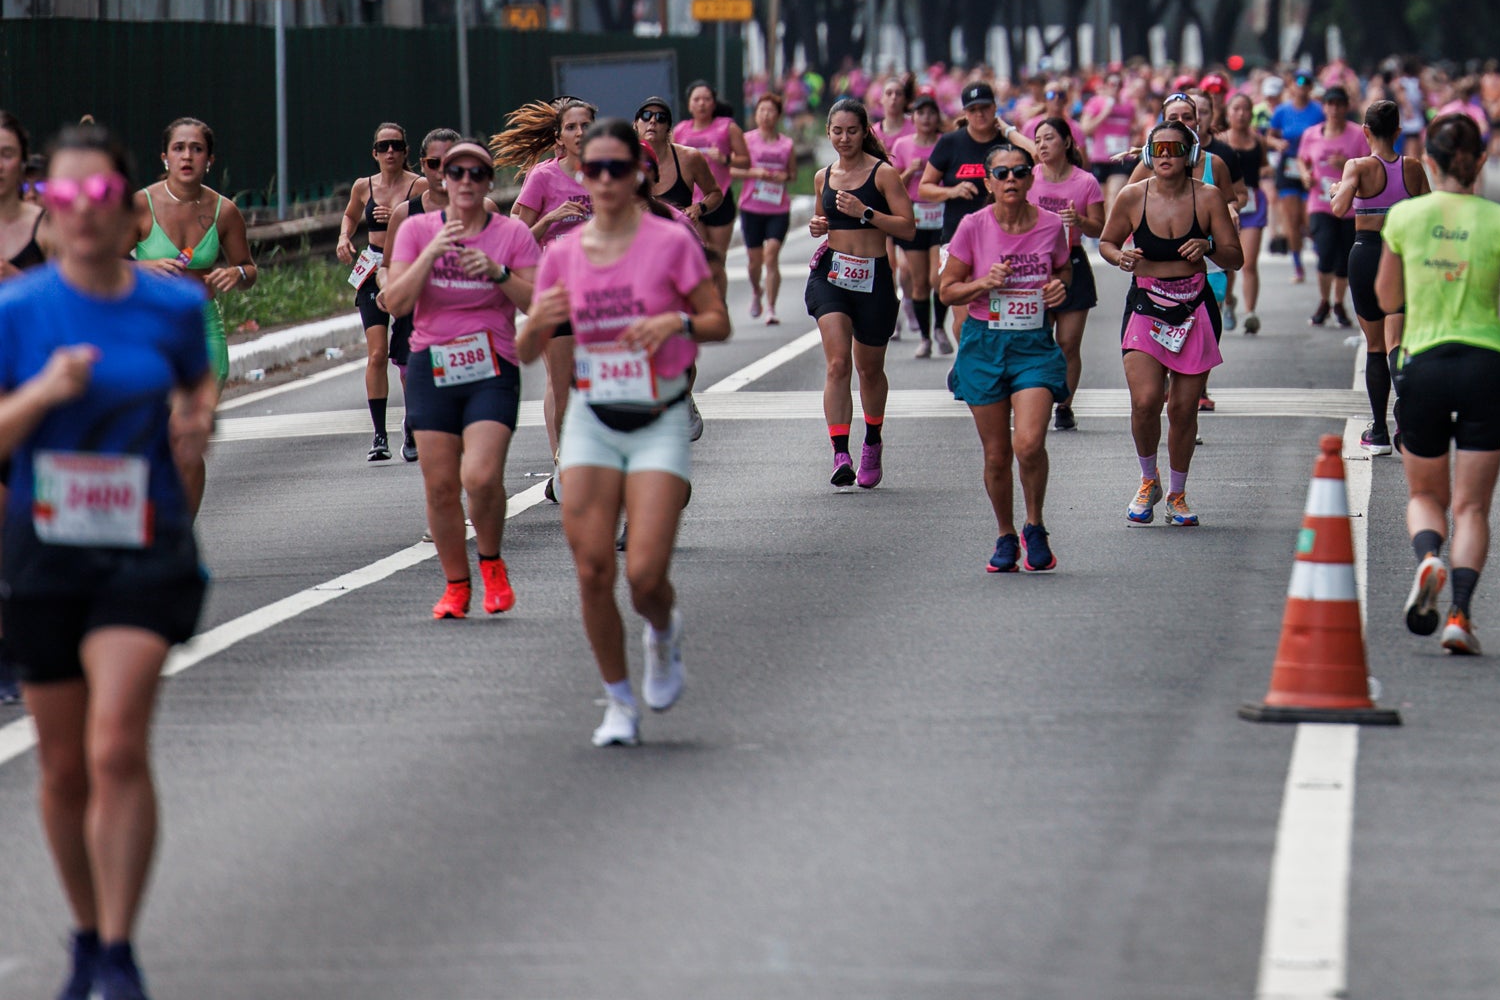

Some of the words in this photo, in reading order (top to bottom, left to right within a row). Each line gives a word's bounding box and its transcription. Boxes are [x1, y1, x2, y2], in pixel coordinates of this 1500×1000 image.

[1431, 224, 1470, 241] Guia
[1000, 252, 1040, 266] VENUS
[844, 266, 870, 280] 2631
[1009, 262, 1048, 277] MEN'S
[1008, 301, 1039, 315] 2215
[1165, 325, 1190, 340] 279
[448, 347, 486, 368] 2388
